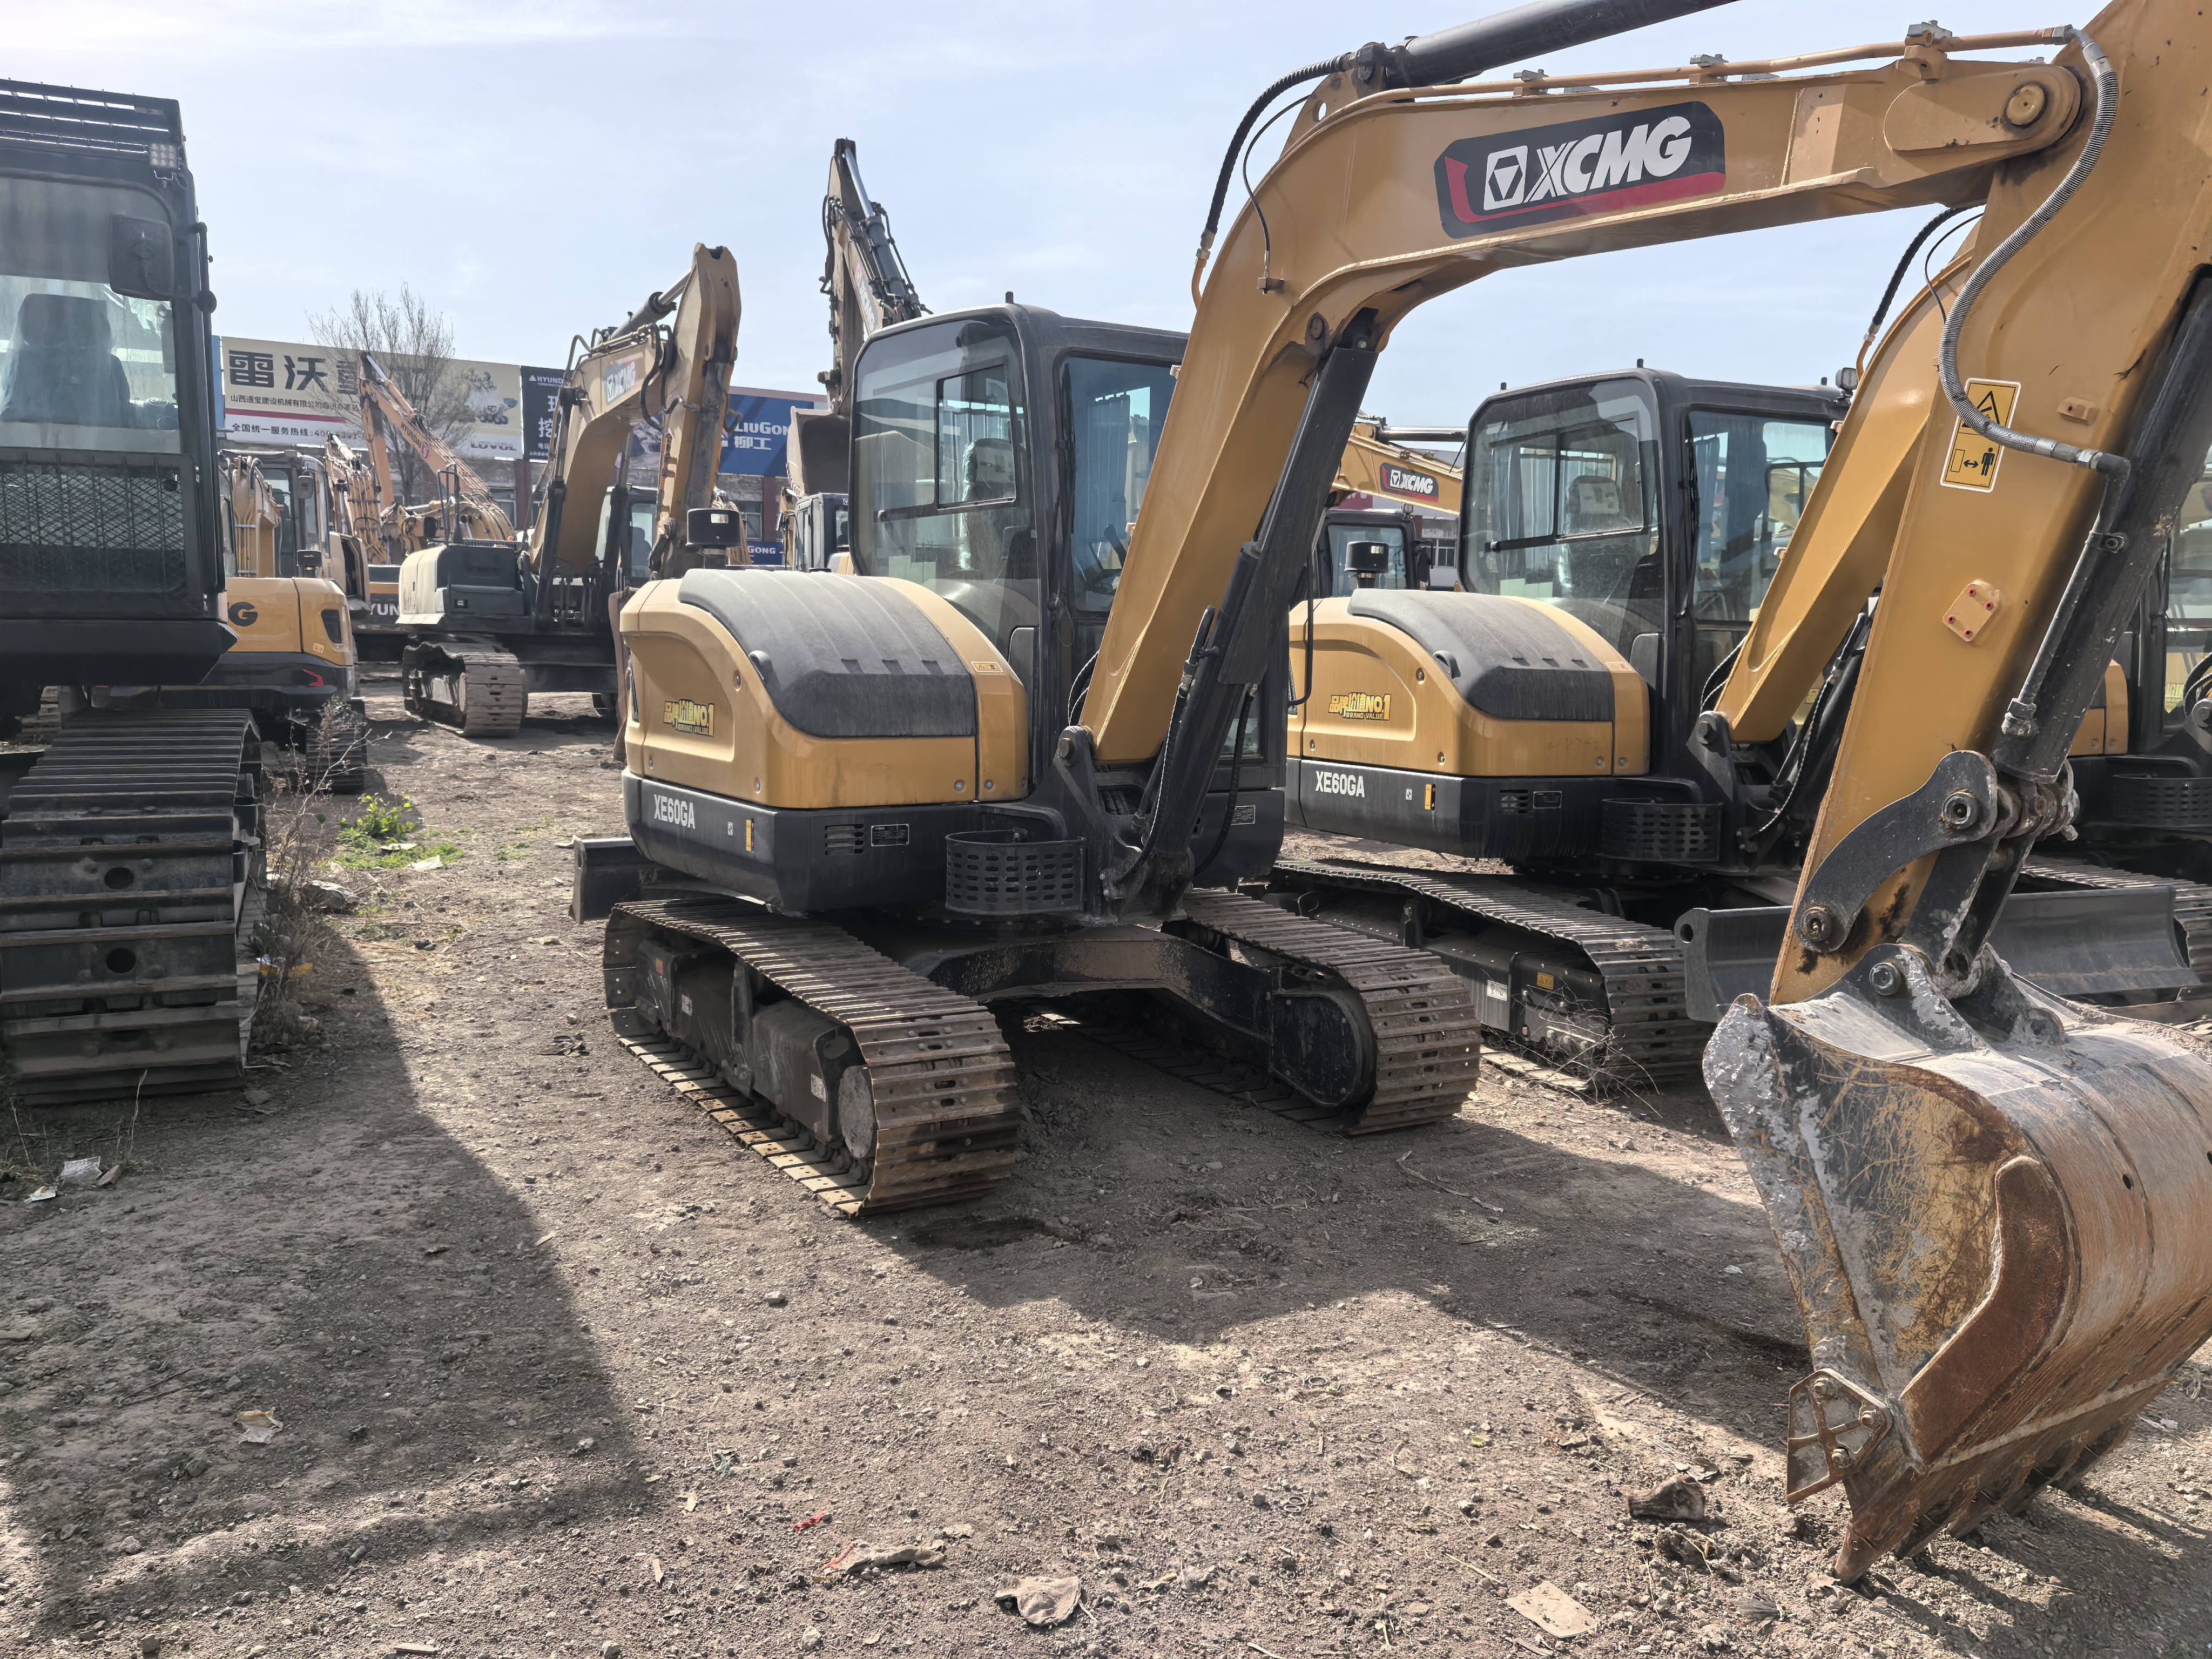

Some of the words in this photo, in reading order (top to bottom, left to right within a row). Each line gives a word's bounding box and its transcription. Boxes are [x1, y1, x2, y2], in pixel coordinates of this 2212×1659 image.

[1522, 116, 1692, 204] XCMG
[537, 375, 563, 384] HYUND
[401, 421, 422, 448] HYUNDAI
[734, 422, 790, 435] LIUGON
[734, 435, 772, 450] 柳工
[1401, 474, 1433, 494] XCMG
[747, 545, 776, 554] GONG
[227, 601, 258, 627] G
[370, 603, 400, 616] YUN
[1315, 771, 1365, 798] XE60GA
[654, 794, 696, 830] XE60GA
